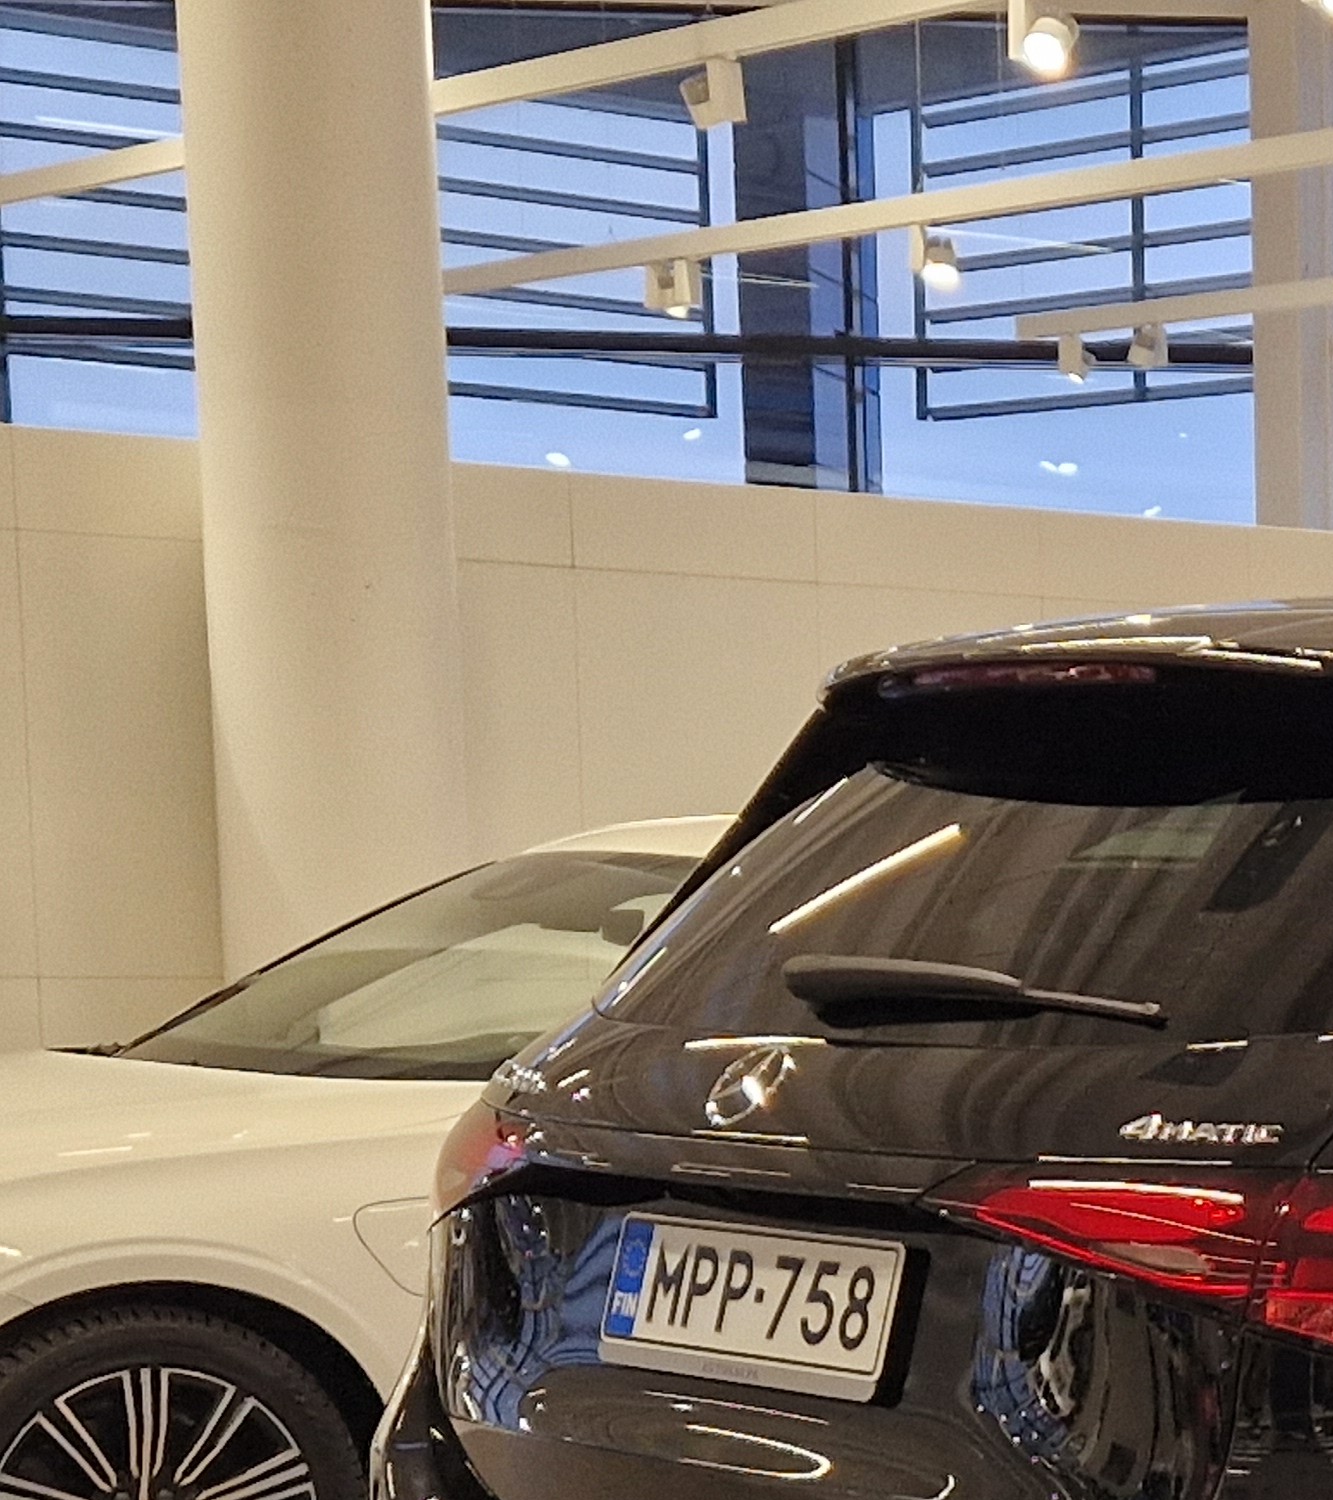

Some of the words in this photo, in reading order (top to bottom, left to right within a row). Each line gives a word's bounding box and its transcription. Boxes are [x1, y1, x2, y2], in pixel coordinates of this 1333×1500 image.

[1118, 1112, 1286, 1145] 4MATIC
[611, 1290, 641, 1319] FIN
[645, 1238, 875, 1351] MPP-758
